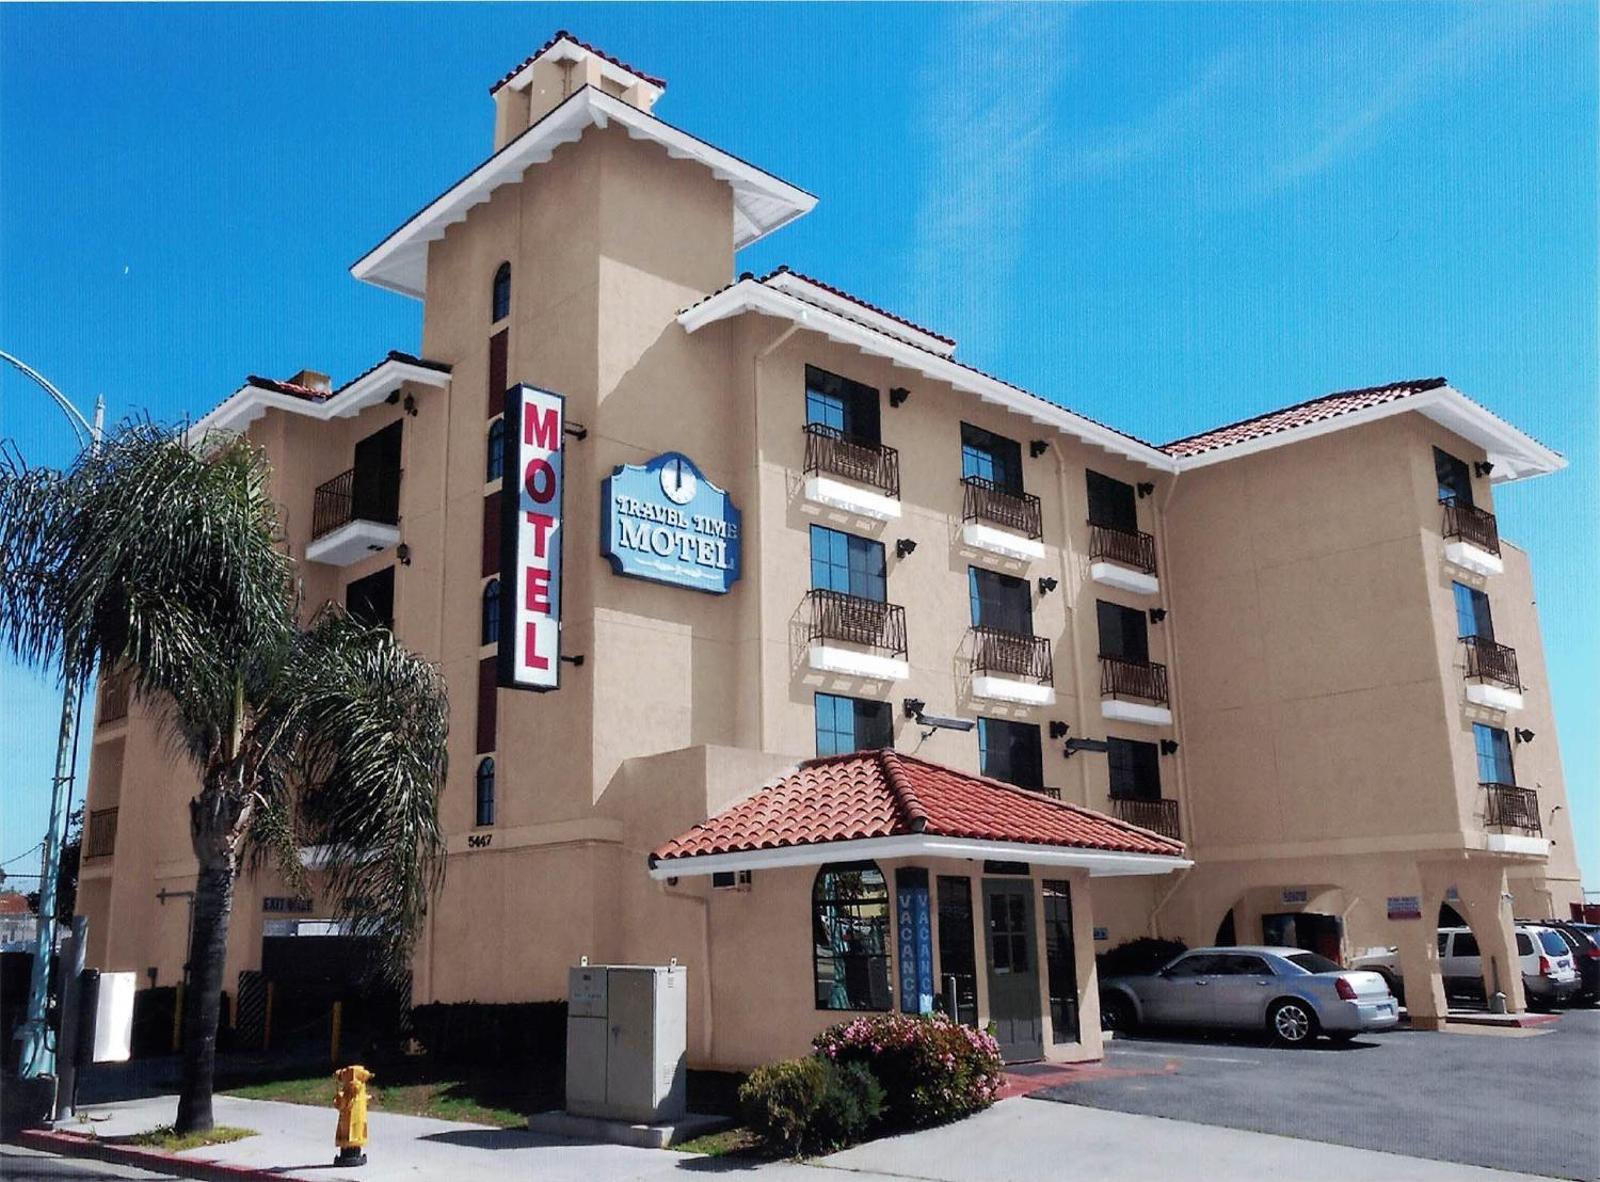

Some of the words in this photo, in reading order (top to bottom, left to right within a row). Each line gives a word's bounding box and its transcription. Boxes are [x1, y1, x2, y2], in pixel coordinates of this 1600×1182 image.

[524, 402, 559, 670] MOTEL
[615, 495, 689, 529] TRAVEL
[692, 514, 738, 539] TIME
[619, 517, 736, 570] MOTEL
[468, 834, 492, 848] 5447
[899, 895, 916, 1010] VACANCY
